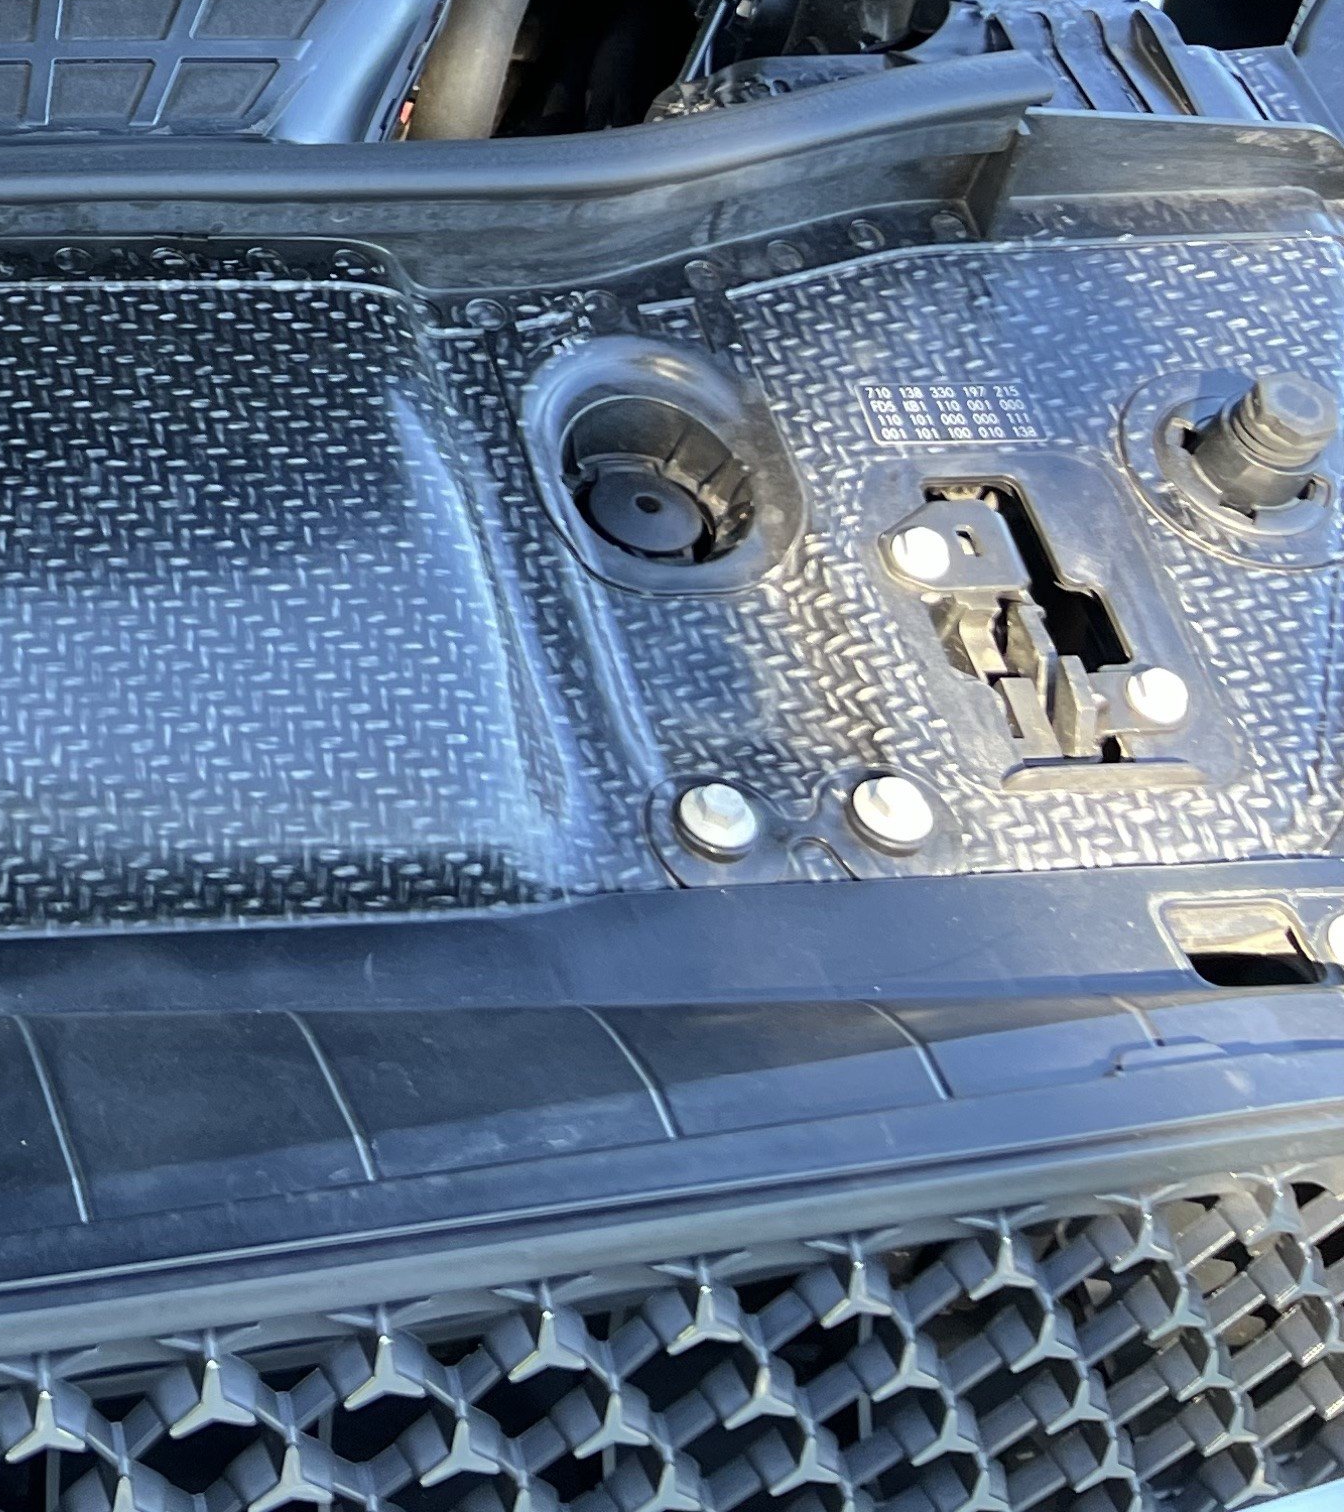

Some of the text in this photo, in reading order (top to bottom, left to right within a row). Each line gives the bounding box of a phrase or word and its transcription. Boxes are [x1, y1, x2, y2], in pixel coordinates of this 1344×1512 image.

[865, 386, 890, 399] 710
[929, 386, 955, 399] 330
[962, 386, 986, 399] 197
[993, 385, 1019, 398] 215
[937, 400, 960, 412] 110
[967, 399, 992, 411] 001
[877, 412, 1030, 426] 110 101 000 000 111
[881, 428, 907, 440] 001
[915, 428, 939, 440] 101
[947, 427, 973, 440] 100
[978, 427, 1004, 439] 010
